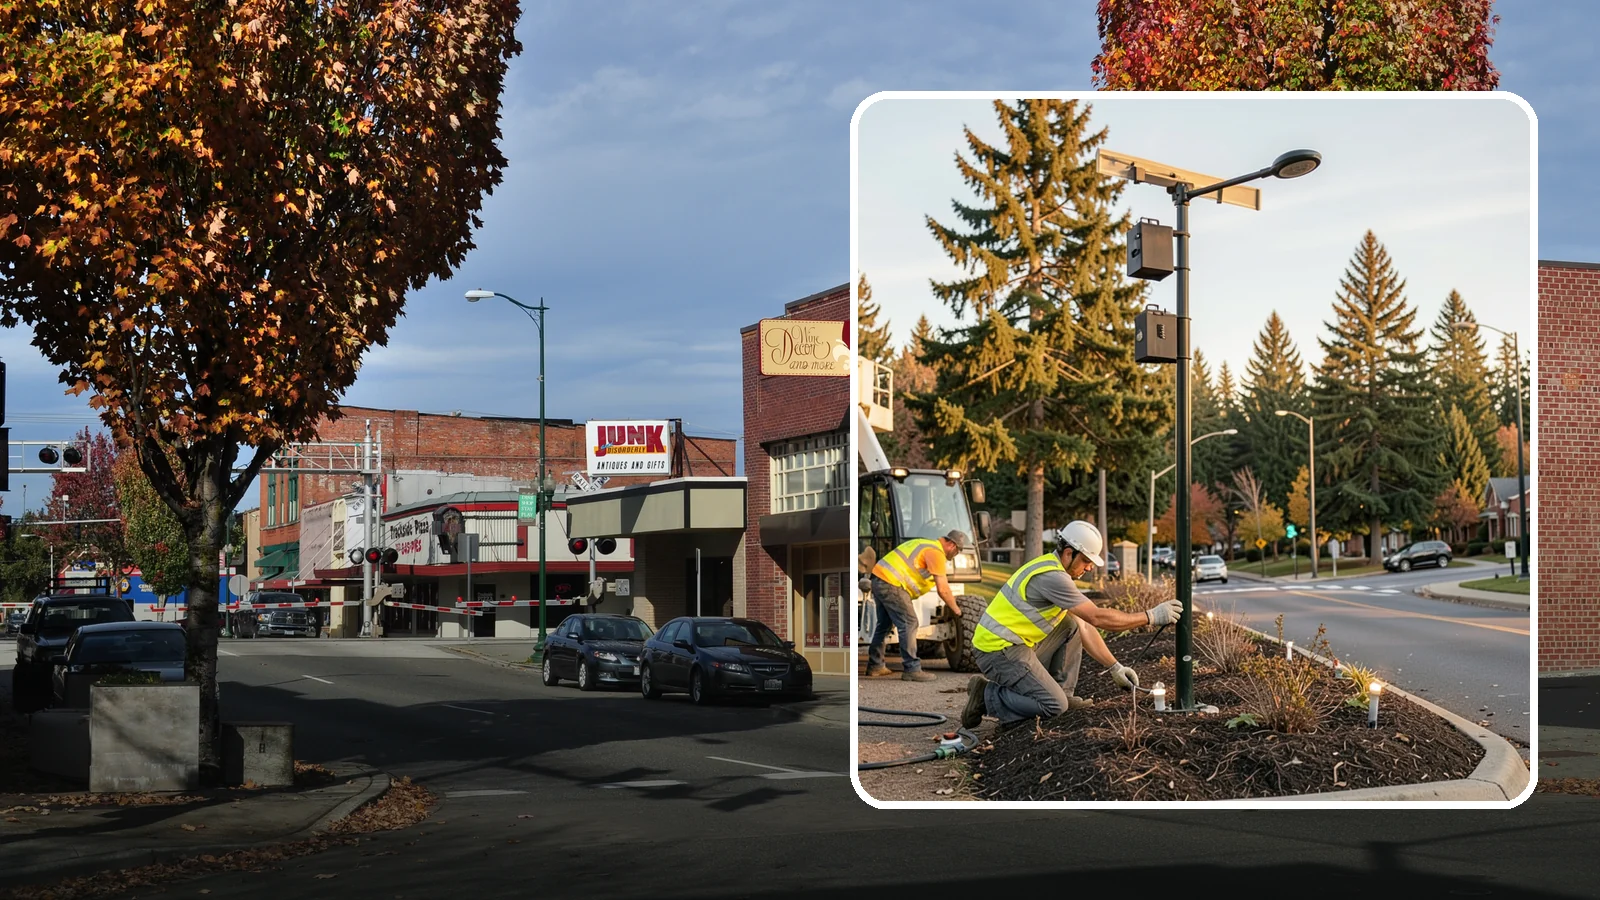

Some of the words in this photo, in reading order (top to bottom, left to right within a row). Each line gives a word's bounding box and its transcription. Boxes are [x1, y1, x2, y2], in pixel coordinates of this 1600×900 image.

[595, 425, 665, 457] JUNK
[607, 446, 646, 454] DISORDERLY
[597, 461, 628, 470] ANTIQUES
[631, 461, 643, 469] AND
[646, 461, 665, 469] GIFTS
[414, 520, 429, 535] Pizza
